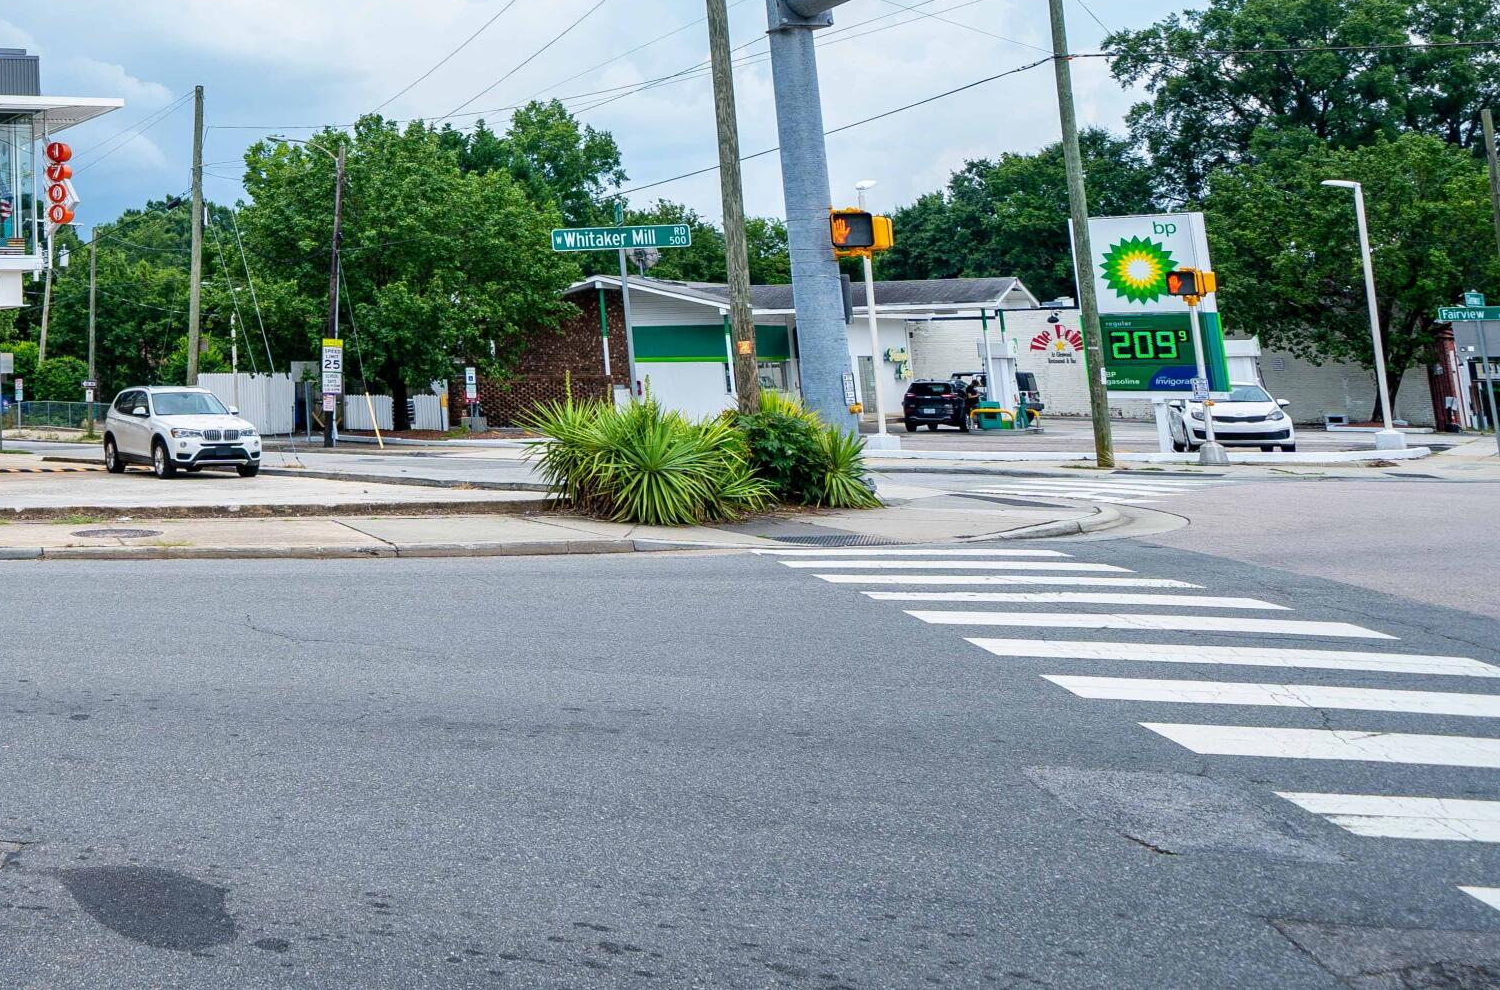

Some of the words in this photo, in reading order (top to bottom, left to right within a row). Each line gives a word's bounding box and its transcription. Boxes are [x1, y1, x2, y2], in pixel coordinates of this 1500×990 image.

[1153, 221, 1176, 237] bp
[564, 231, 627, 248] Whitaker
[632, 229, 656, 246] Mill
[673, 227, 686, 236] RD
[669, 236, 687, 245] 500
[1442, 309, 1485, 320] Fairview
[1029, 330, 1052, 352] The
[324, 359, 340, 370] 25
[1106, 378, 1140, 386] gasoline
